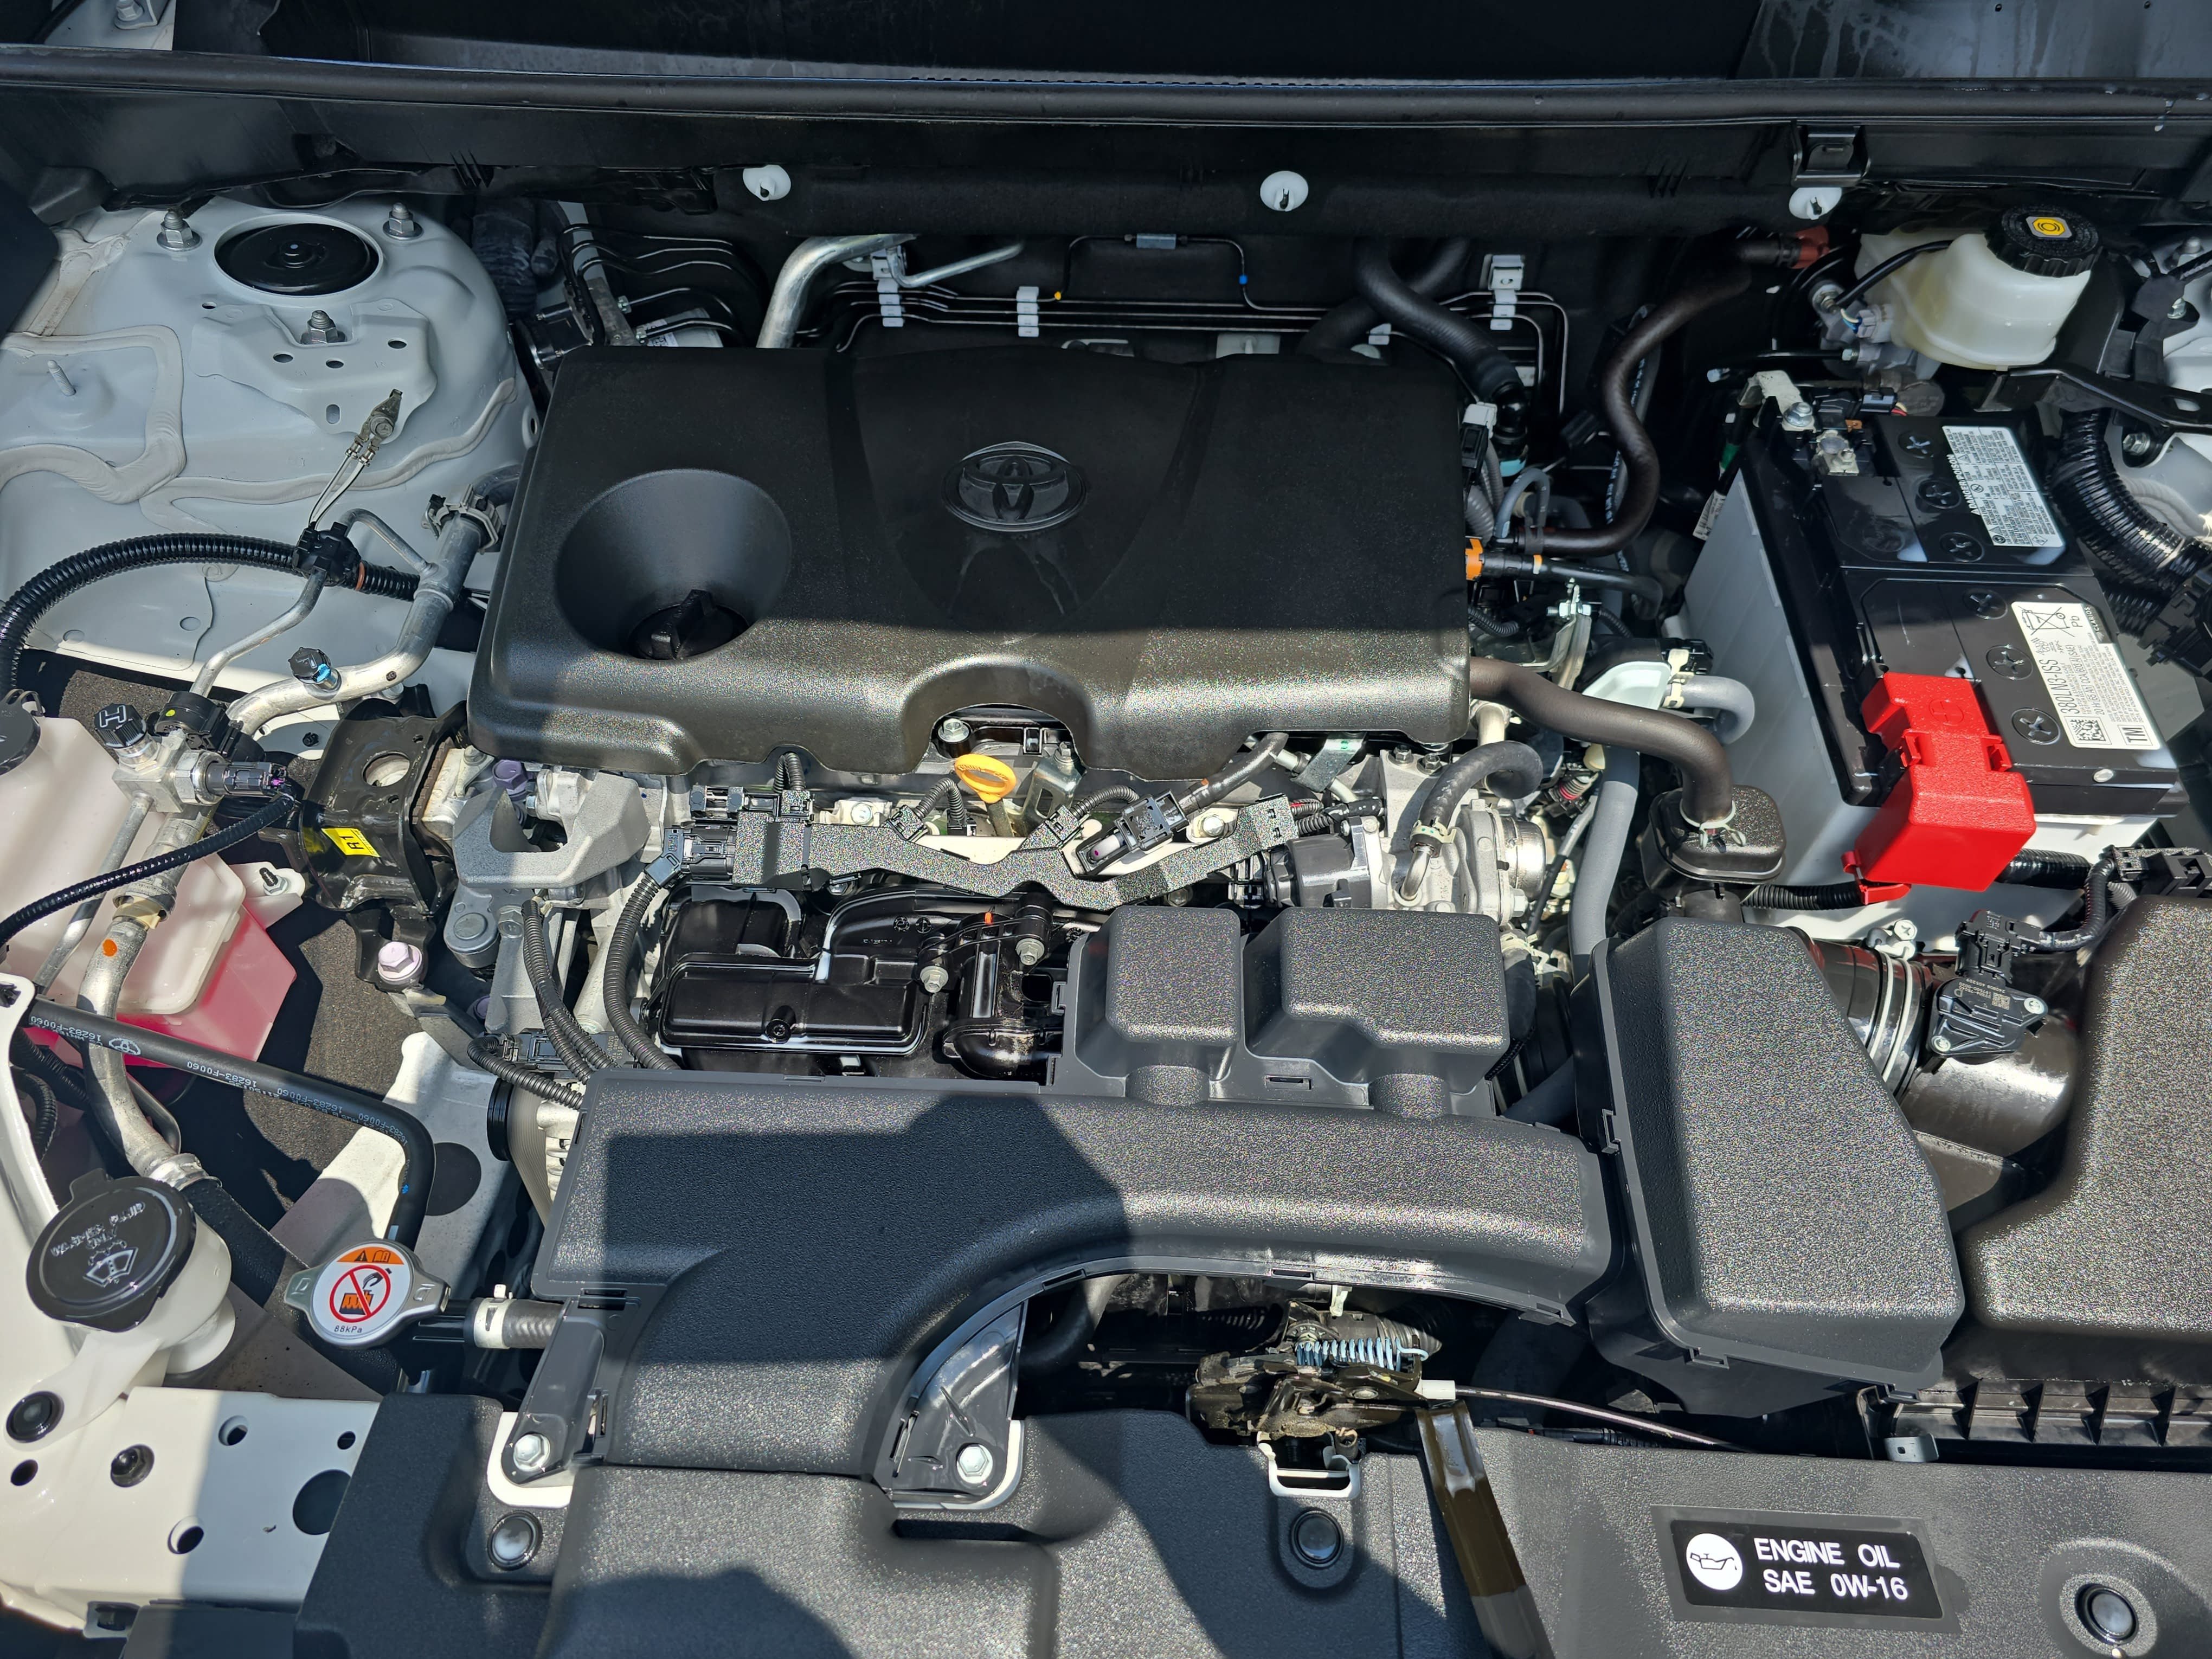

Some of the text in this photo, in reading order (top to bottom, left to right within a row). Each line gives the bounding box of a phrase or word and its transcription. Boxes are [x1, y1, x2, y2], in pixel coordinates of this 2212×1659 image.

[1945, 453, 1977, 509] DANGER/POISON
[2069, 615, 2084, 627] Pb
[2082, 606, 2100, 631] CLARIOS
[2064, 644, 2080, 657] (SAE)
[2037, 659, 2080, 714] 380LN3-ISS
[2077, 673, 2091, 683] CCA
[99, 704, 127, 728] H
[2126, 727, 2150, 743] TM
[30, 1015, 102, 1041] 16283-F0060
[185, 1060, 258, 1088] 16283-F0060
[276, 1086, 343, 1114] 16283-F0060
[357, 1111, 409, 1145] 16283-F0060
[334, 1324, 362, 1333] 88kPa
[1753, 1538, 1900, 1569] ENGINE OIL
[1763, 1569, 1908, 1601] SAE 0W-16
